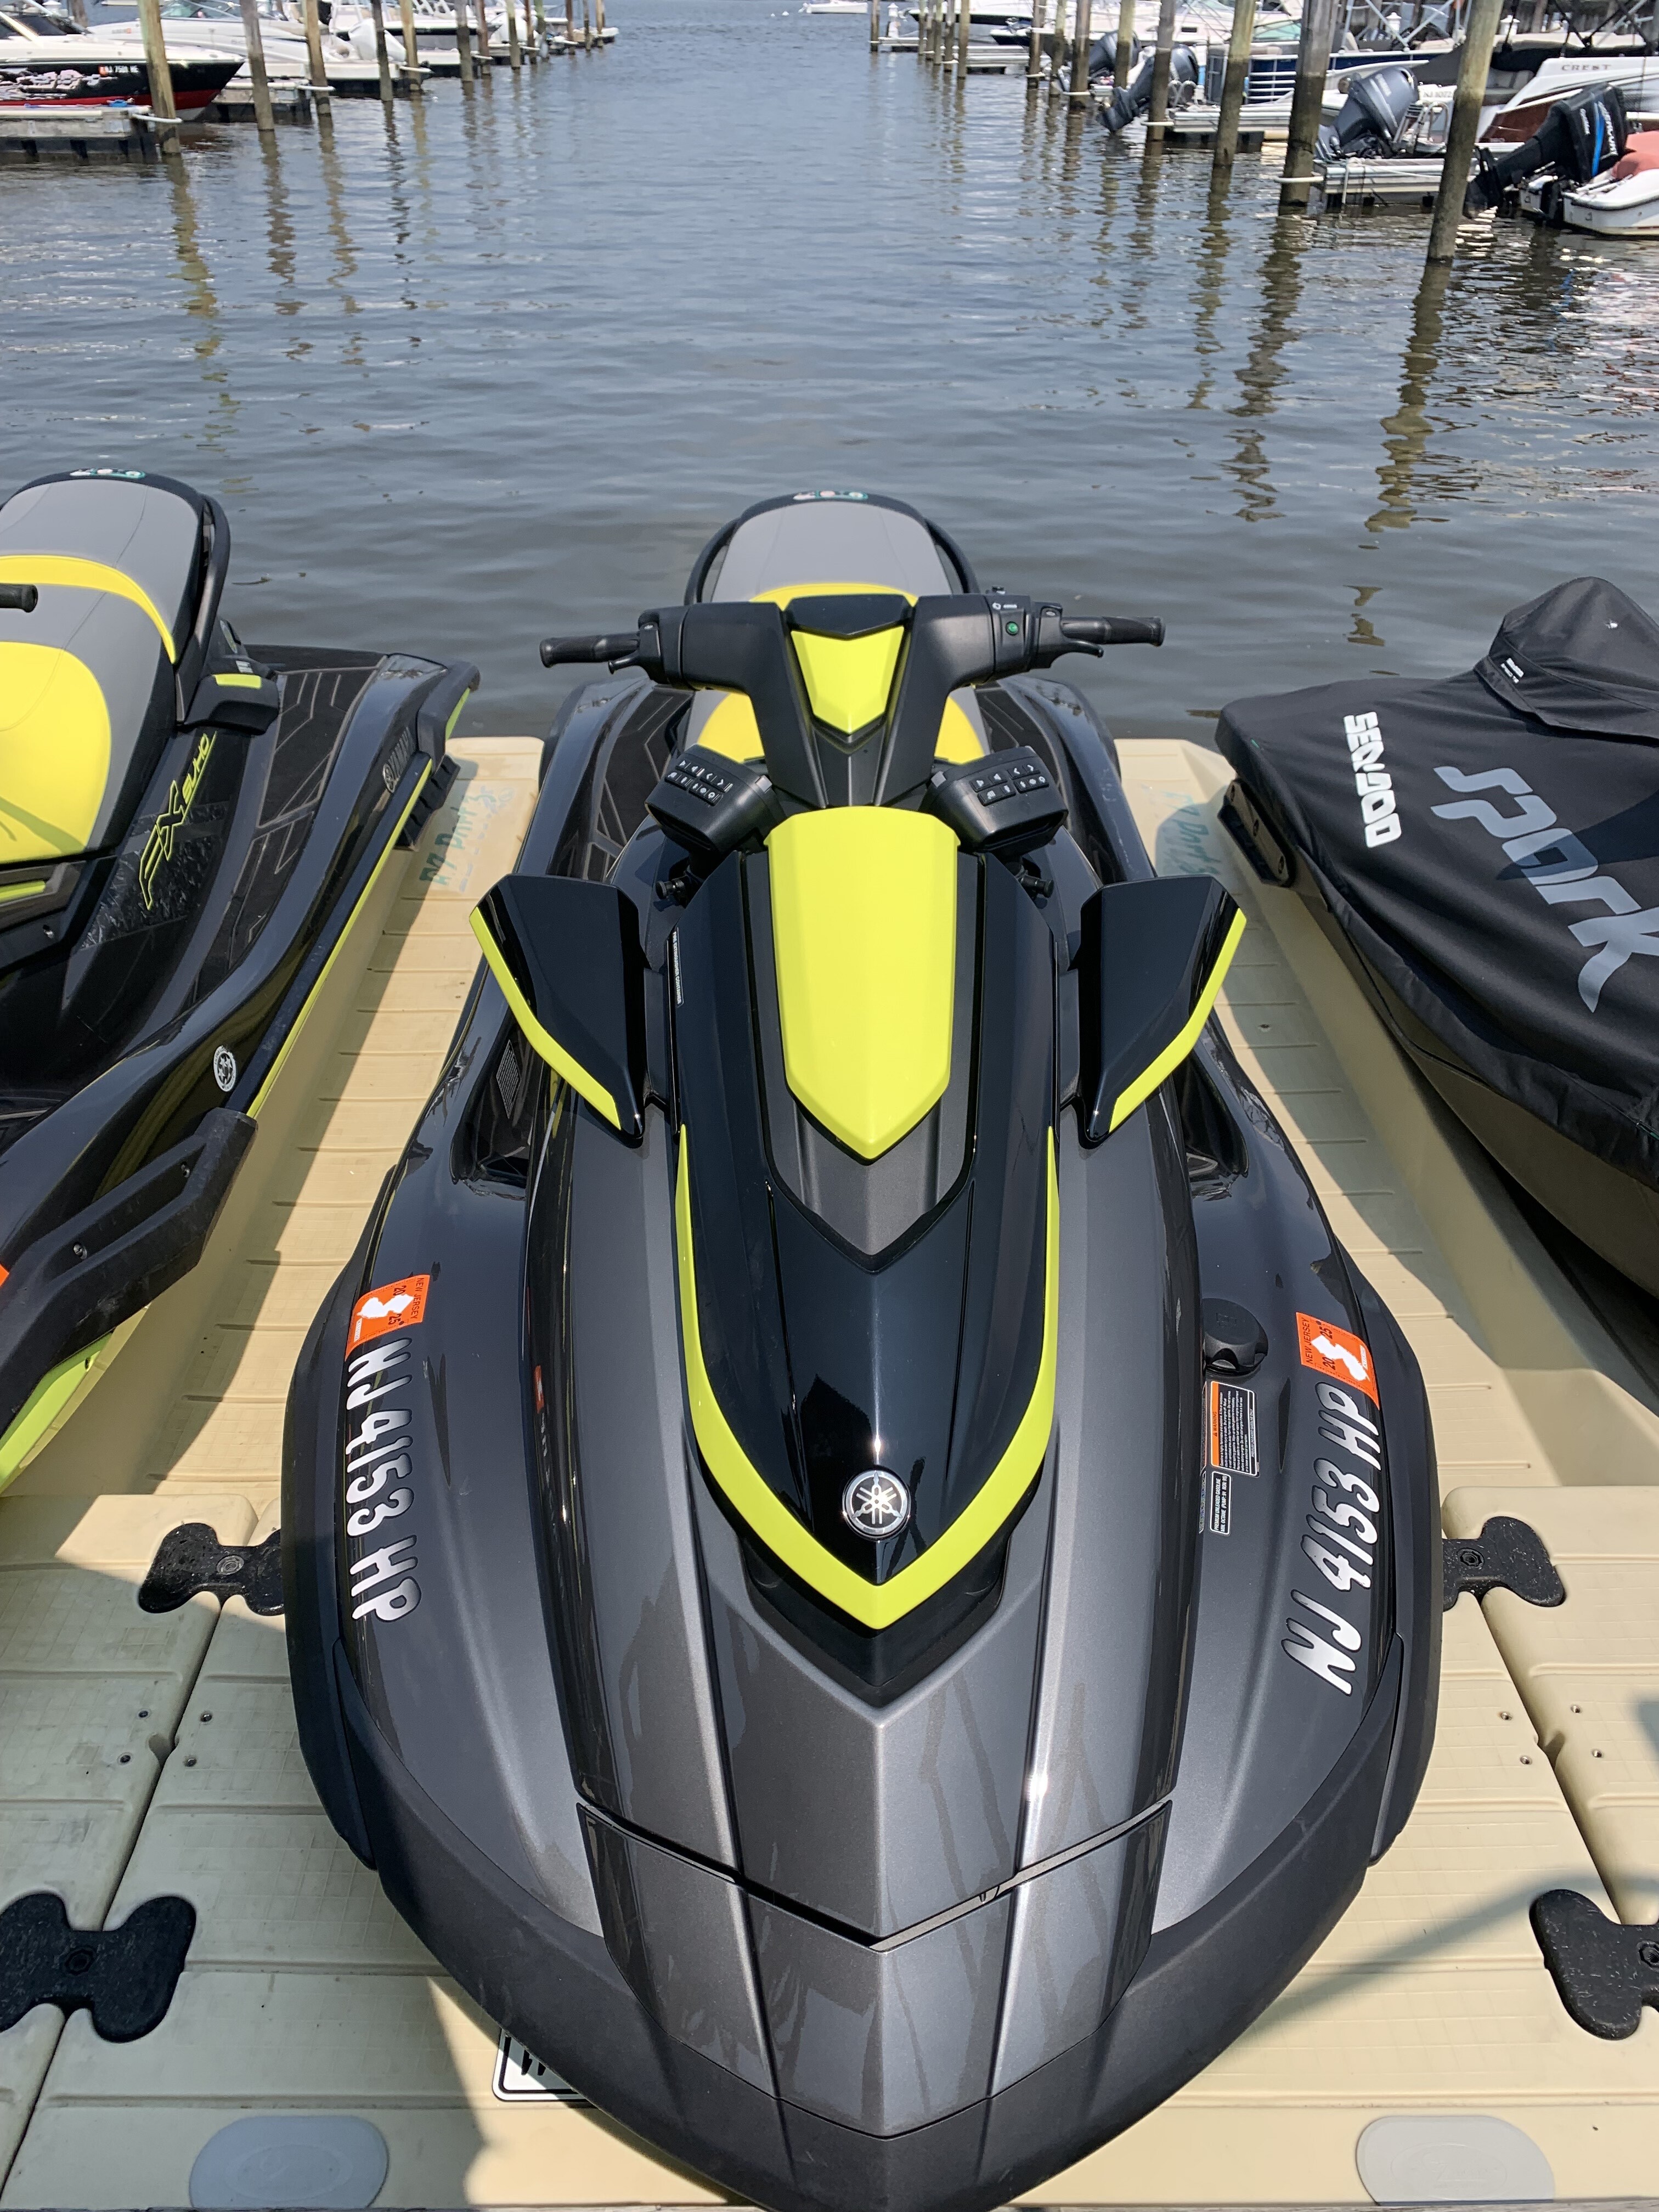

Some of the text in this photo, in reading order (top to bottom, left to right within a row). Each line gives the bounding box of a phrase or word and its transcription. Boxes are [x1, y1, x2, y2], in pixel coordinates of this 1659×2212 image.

[393, 1285, 407, 1296] 20
[410, 1278, 425, 1319] NEW JERSEY
[388, 1313, 402, 1325] 25
[1301, 1317, 1312, 1345] JERSEY
[1319, 1325, 1333, 1340] 25
[1322, 1356, 1335, 1370] 20
[345, 1338, 422, 1623] NJ 4153 HP
[1282, 1381, 1381, 1696] NJ 4153 HP
